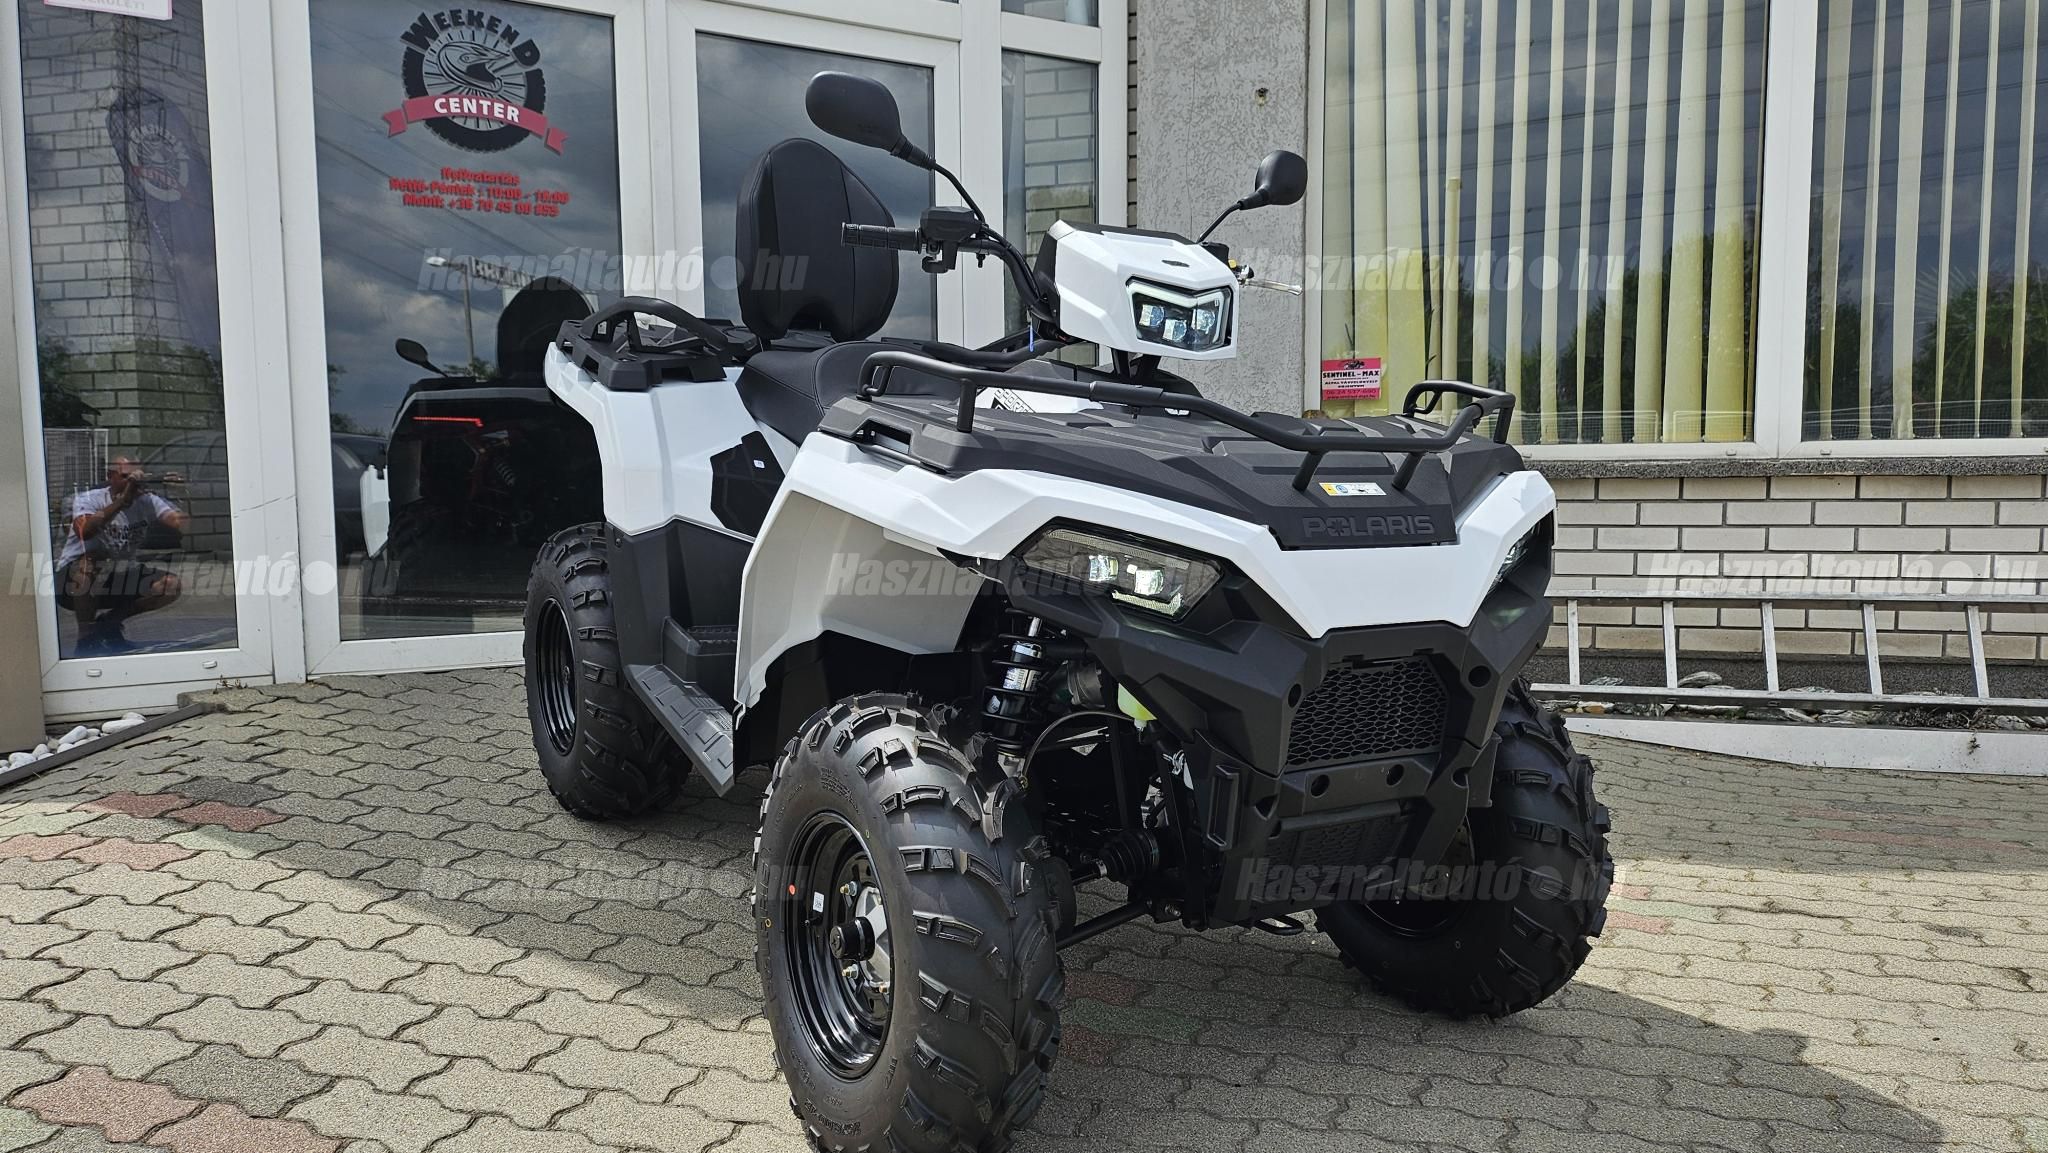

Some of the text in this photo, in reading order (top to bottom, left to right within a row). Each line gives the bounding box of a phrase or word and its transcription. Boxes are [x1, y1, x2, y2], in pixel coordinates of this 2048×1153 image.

[400, 8, 541, 67] WEEKEND
[434, 97, 520, 123] CENTER
[1322, 371, 1356, 379] SENTINEL
[1302, 515, 1436, 538] POLARIS
